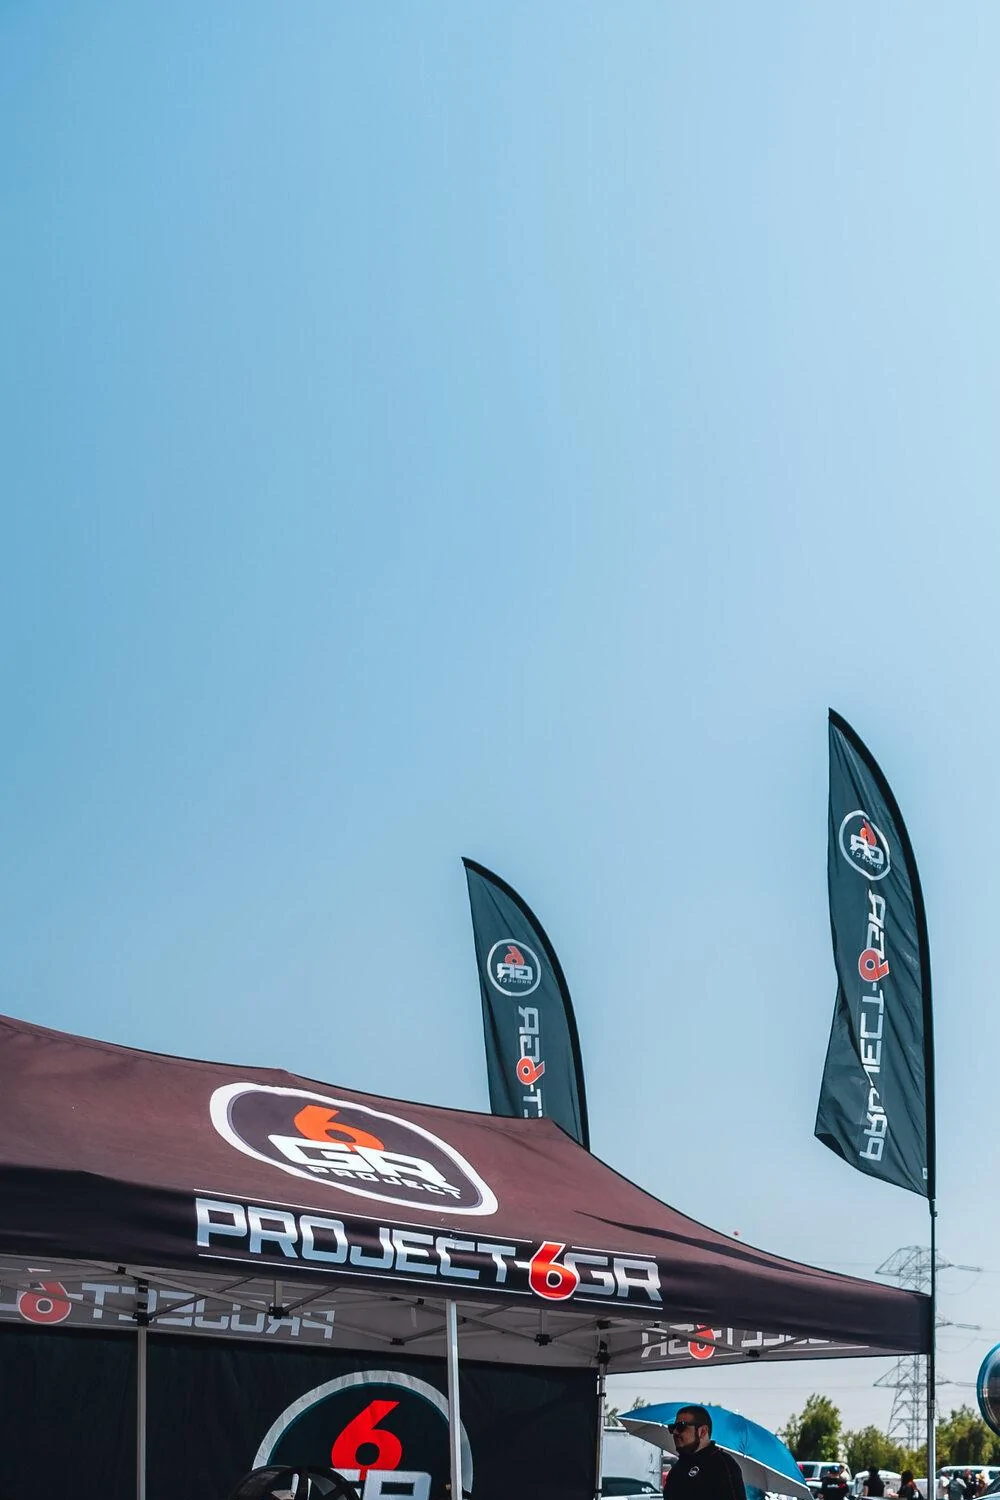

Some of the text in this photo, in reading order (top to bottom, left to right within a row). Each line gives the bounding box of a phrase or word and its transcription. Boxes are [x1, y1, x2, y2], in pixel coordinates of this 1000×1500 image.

[293, 1104, 386, 1152] 6
[267, 1134, 463, 1191] GR
[306, 1164, 461, 1200] PROJECT
[195, 1197, 663, 1302] PROJECT-6GR
[331, 1399, 403, 1481] 6
